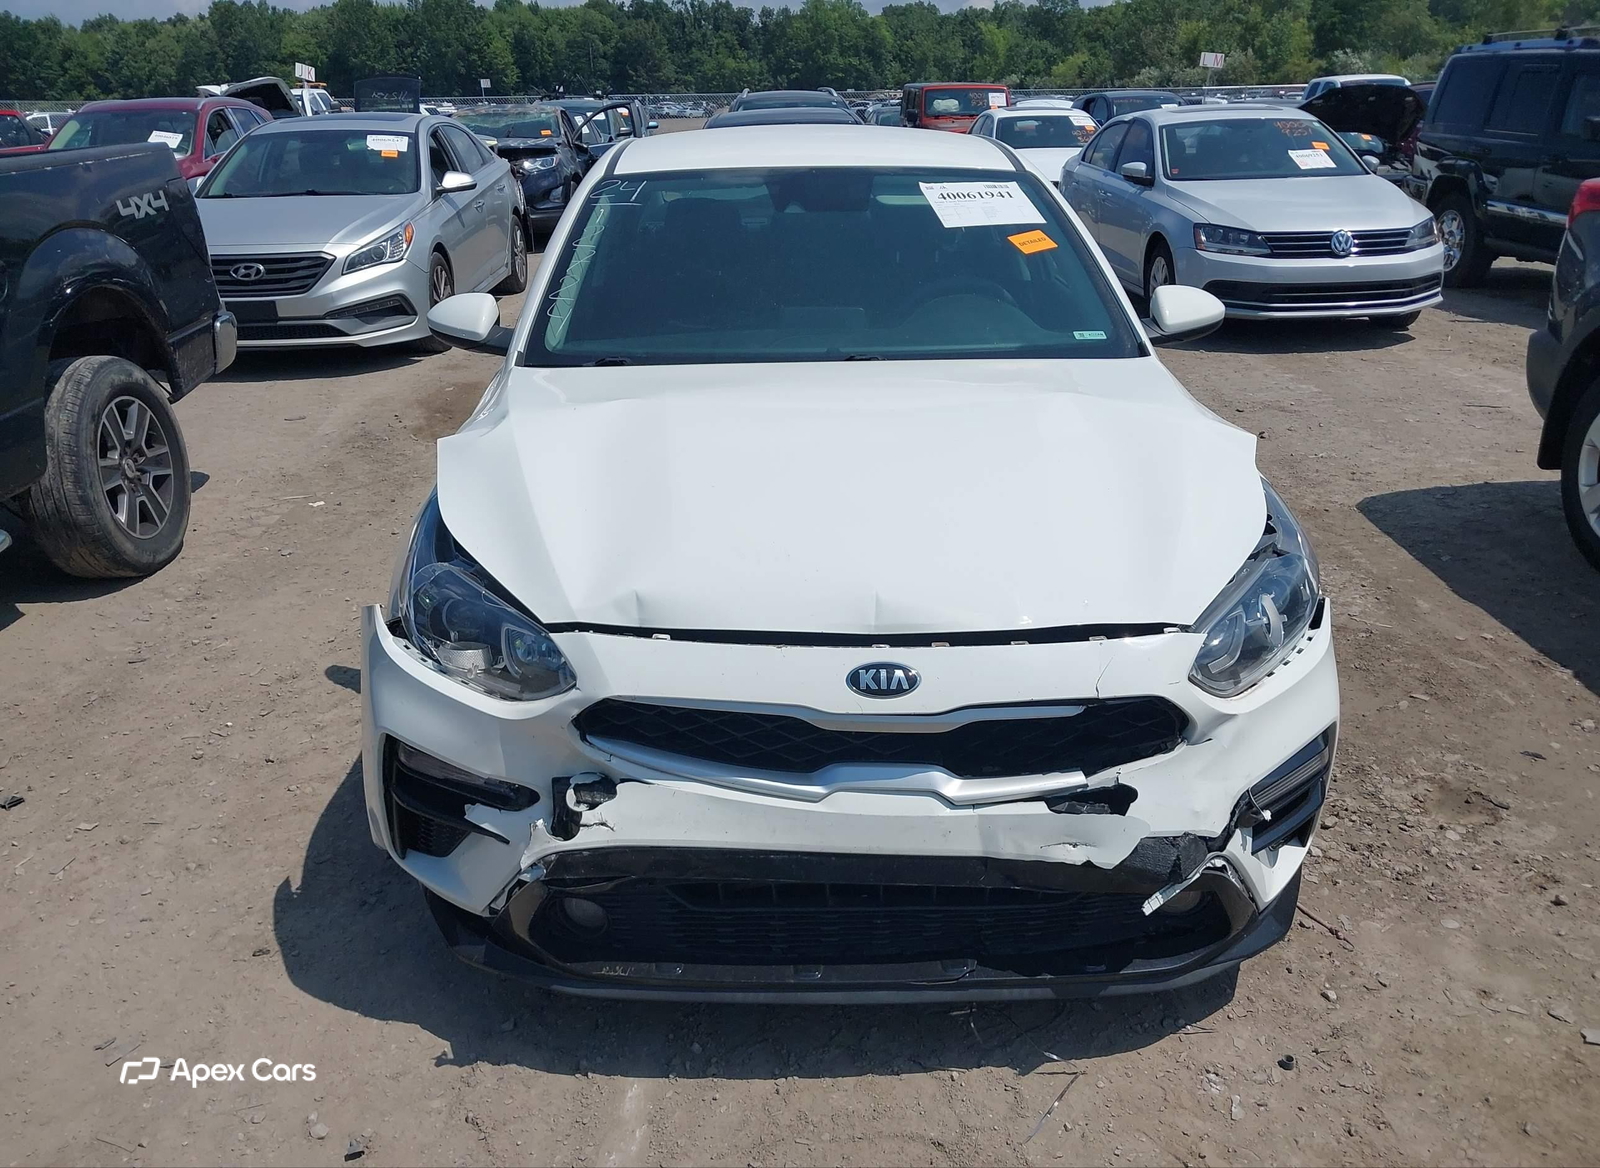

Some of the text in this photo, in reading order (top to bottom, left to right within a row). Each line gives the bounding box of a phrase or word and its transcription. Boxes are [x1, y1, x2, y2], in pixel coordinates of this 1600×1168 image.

[1212, 53, 1224, 67] M
[589, 179, 648, 202] 24
[937, 190, 1014, 201] 40061941
[1018, 236, 1047, 247] DETAILED
[858, 668, 910, 690] KIA
